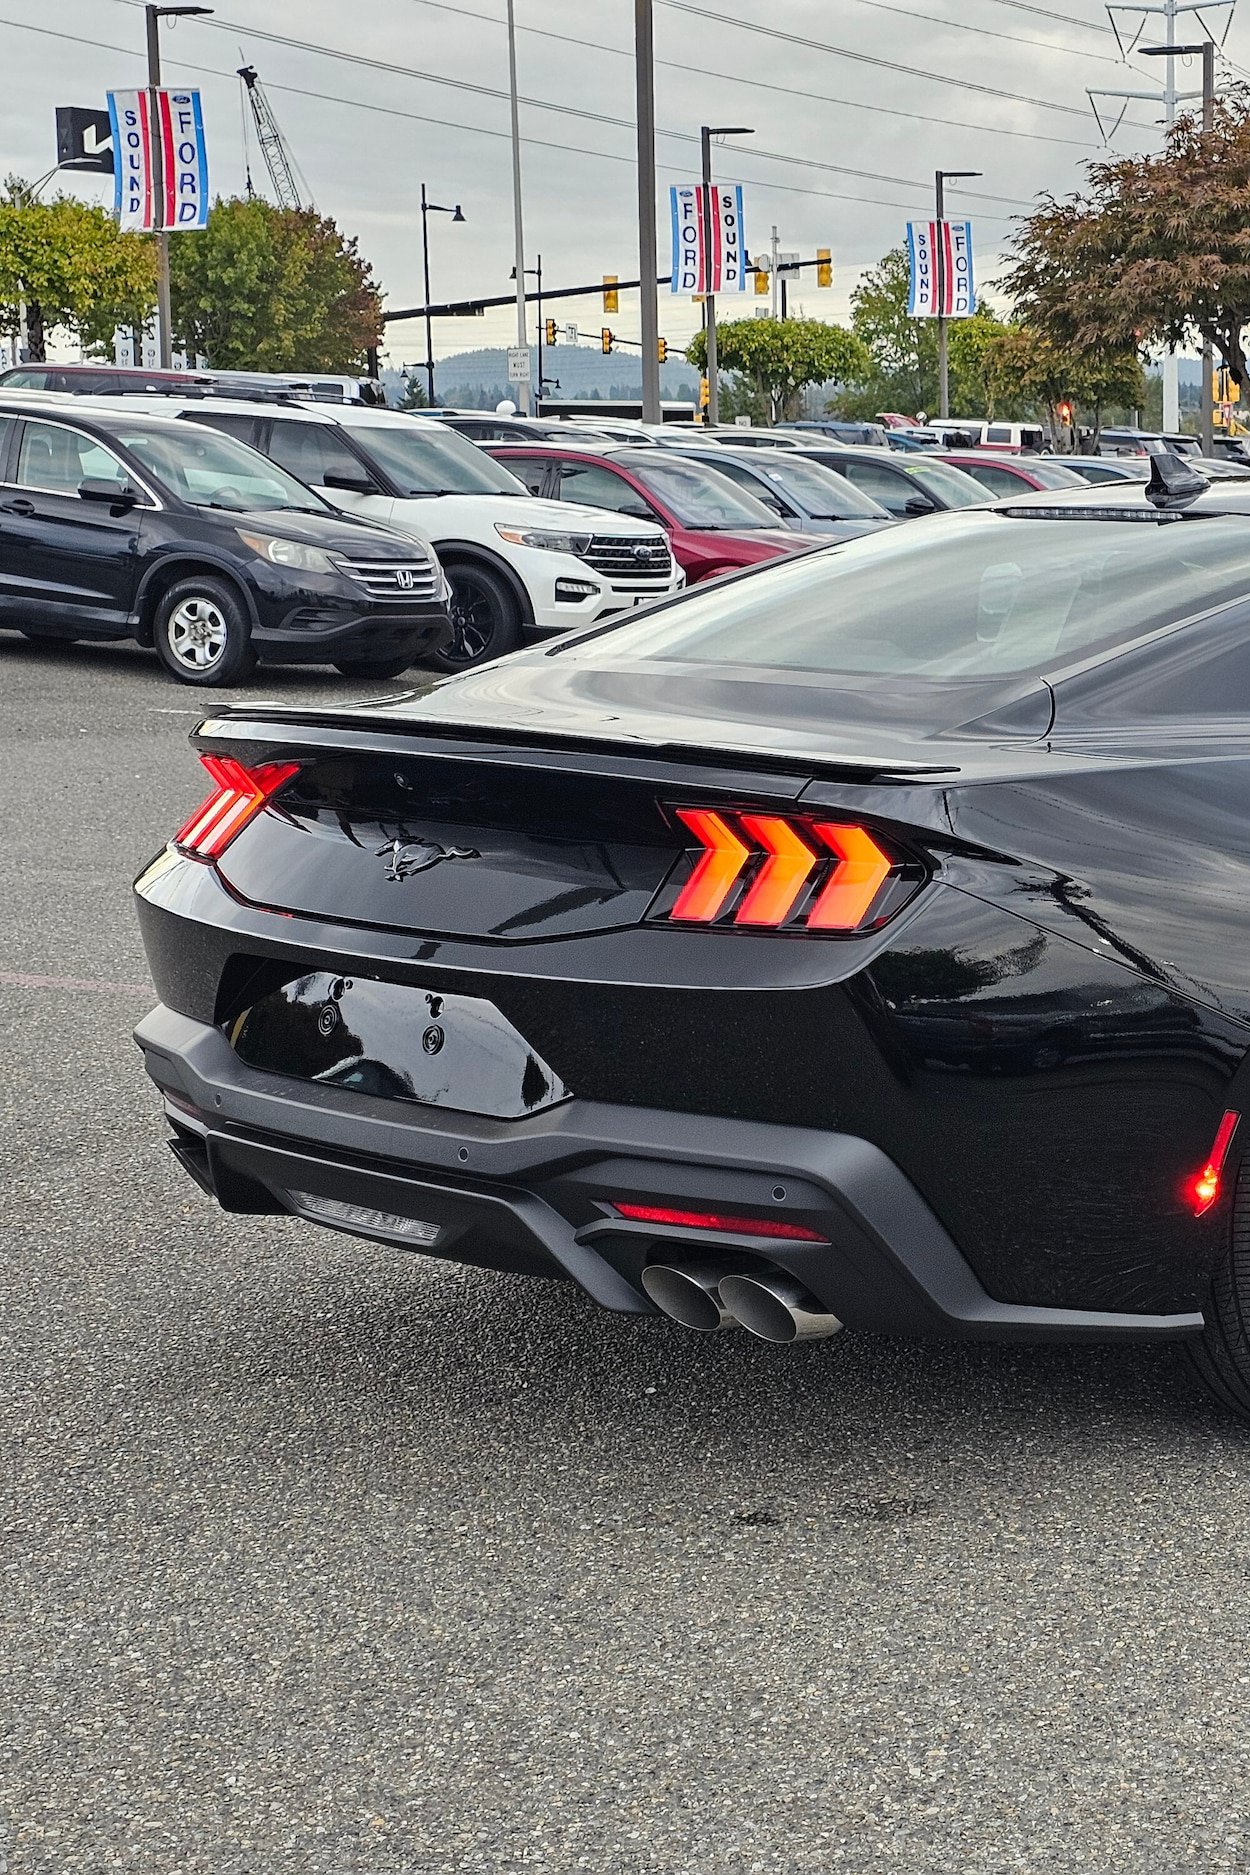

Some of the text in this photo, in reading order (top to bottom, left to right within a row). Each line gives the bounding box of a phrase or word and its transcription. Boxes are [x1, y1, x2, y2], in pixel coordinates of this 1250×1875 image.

[124, 110, 140, 213] SOUND
[178, 111, 197, 222] FORD
[682, 203, 697, 289] FORD
[722, 196, 737, 281] SOUND
[918, 234, 929, 304] SOUND
[955, 236, 968, 312] FORD
